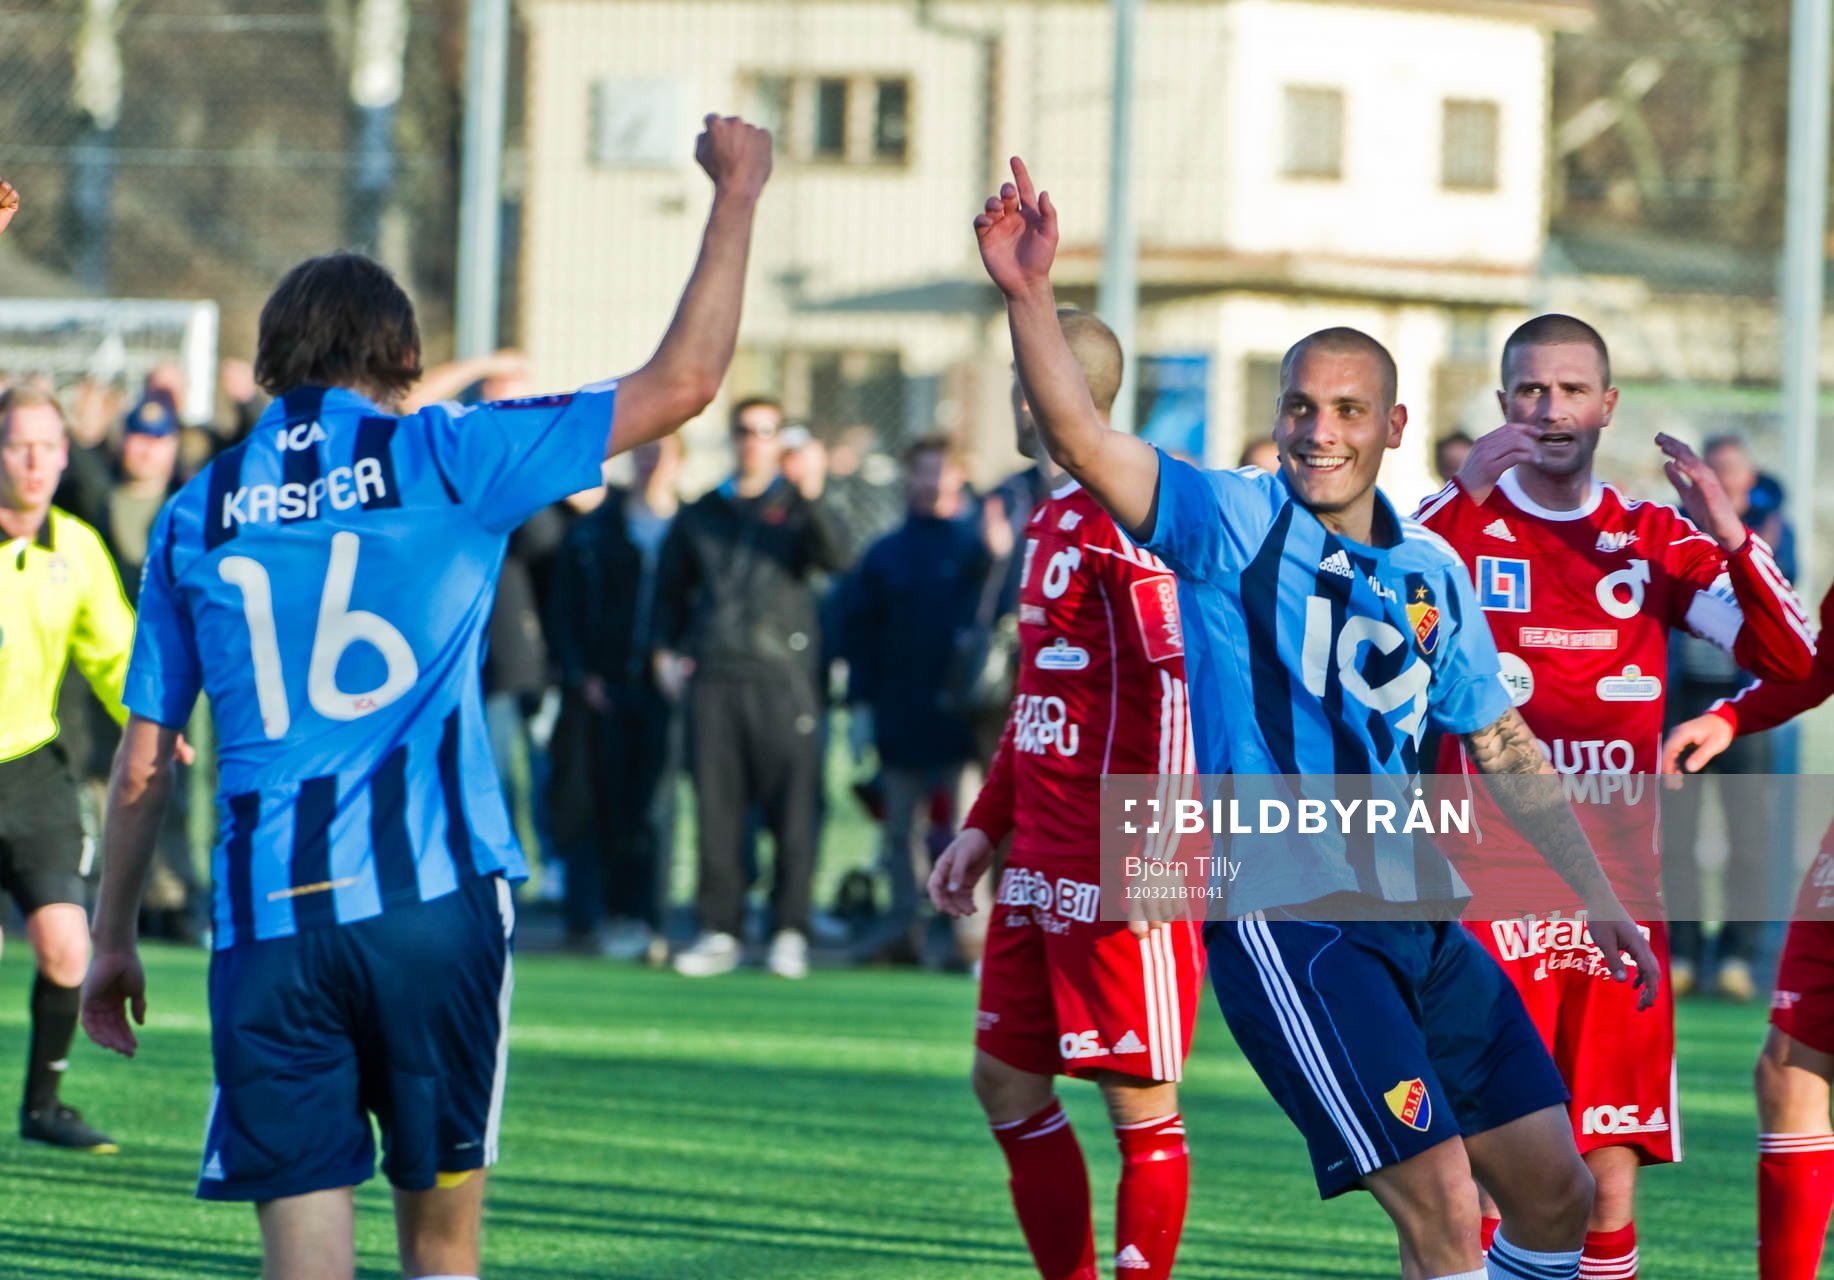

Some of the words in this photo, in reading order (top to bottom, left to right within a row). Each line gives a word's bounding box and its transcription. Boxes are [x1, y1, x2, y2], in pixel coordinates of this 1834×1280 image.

[276, 421, 326, 451] ICA
[222, 457, 386, 528] KASPER
[1319, 561, 1355, 579] adidas
[218, 531, 419, 740] 16
[1157, 583, 1183, 648] Adecco
[1555, 768, 1646, 806] MPU
[1056, 877, 1100, 923] Bil
